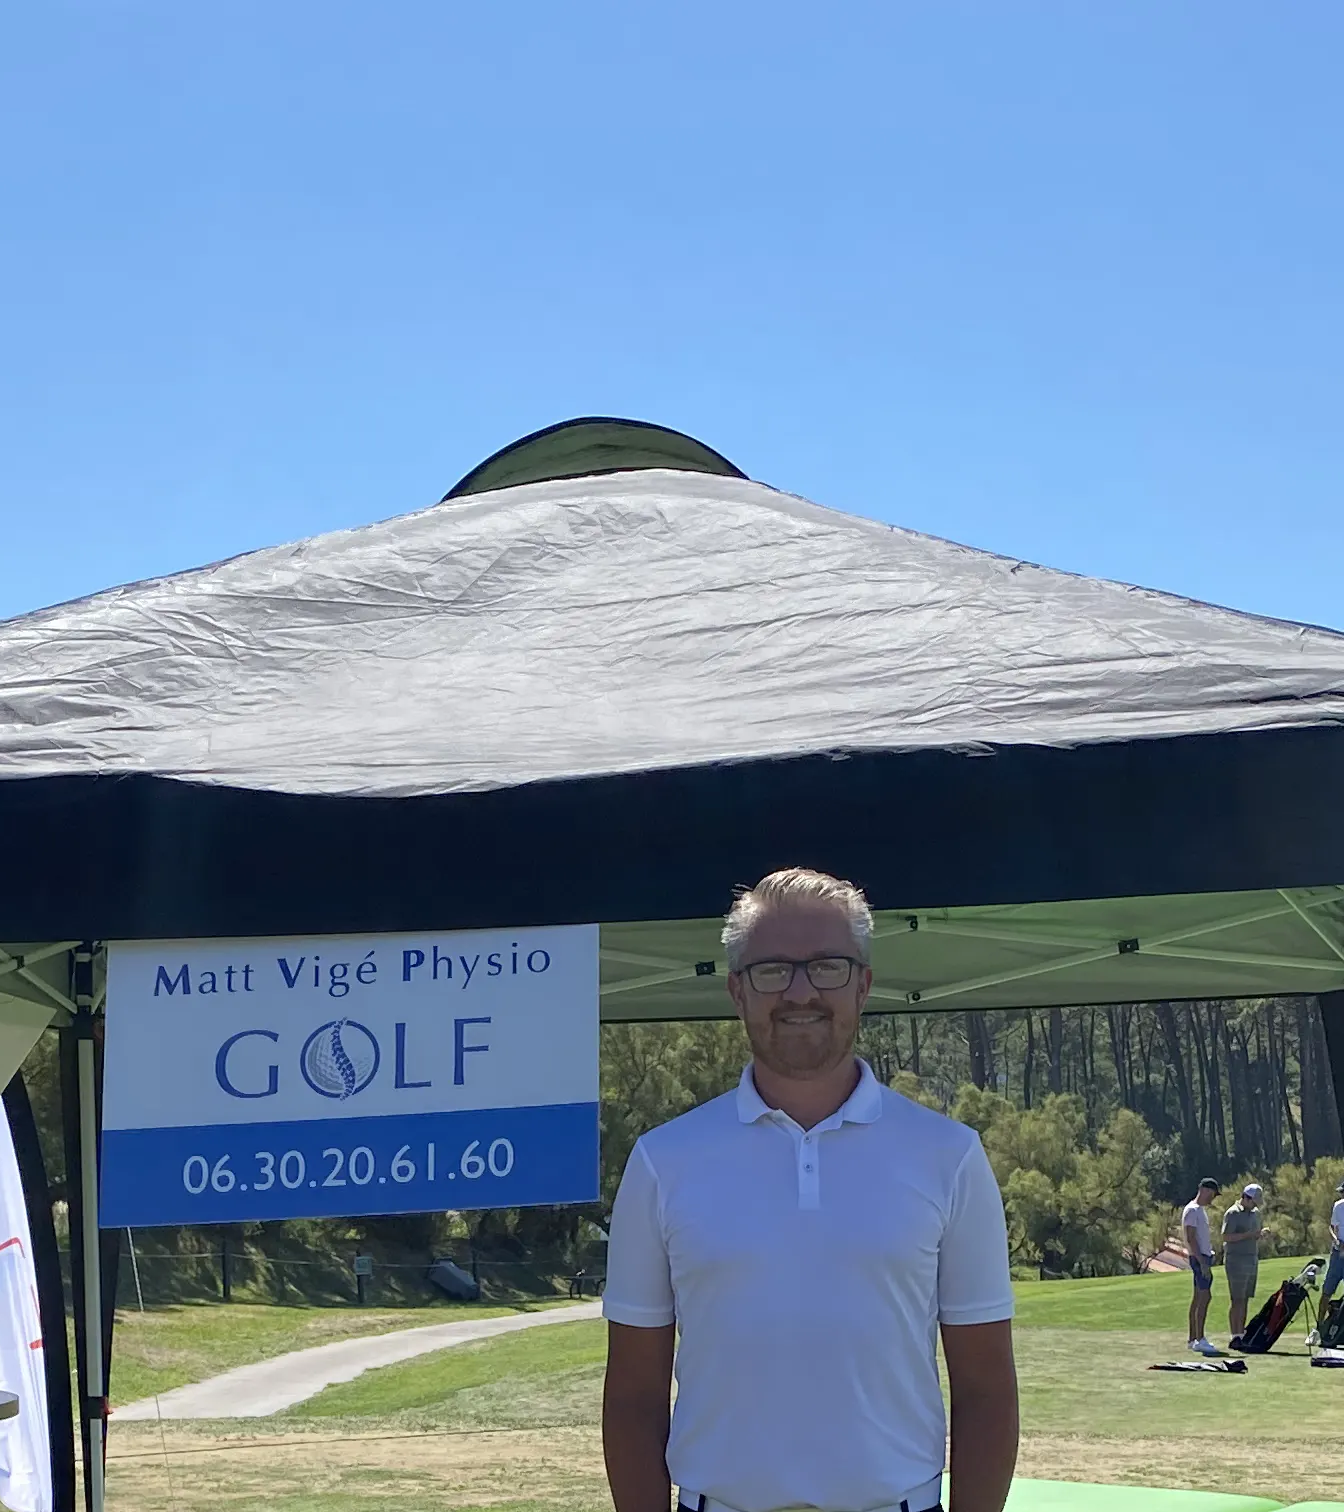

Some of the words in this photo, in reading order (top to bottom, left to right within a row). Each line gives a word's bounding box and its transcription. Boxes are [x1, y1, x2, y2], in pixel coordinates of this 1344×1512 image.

[153, 962, 255, 997] Matt
[276, 950, 379, 998] Vigé
[401, 942, 552, 990] Physio
[215, 1015, 493, 1101] GOLF
[182, 1137, 515, 1195] 06.30.20.61.60
